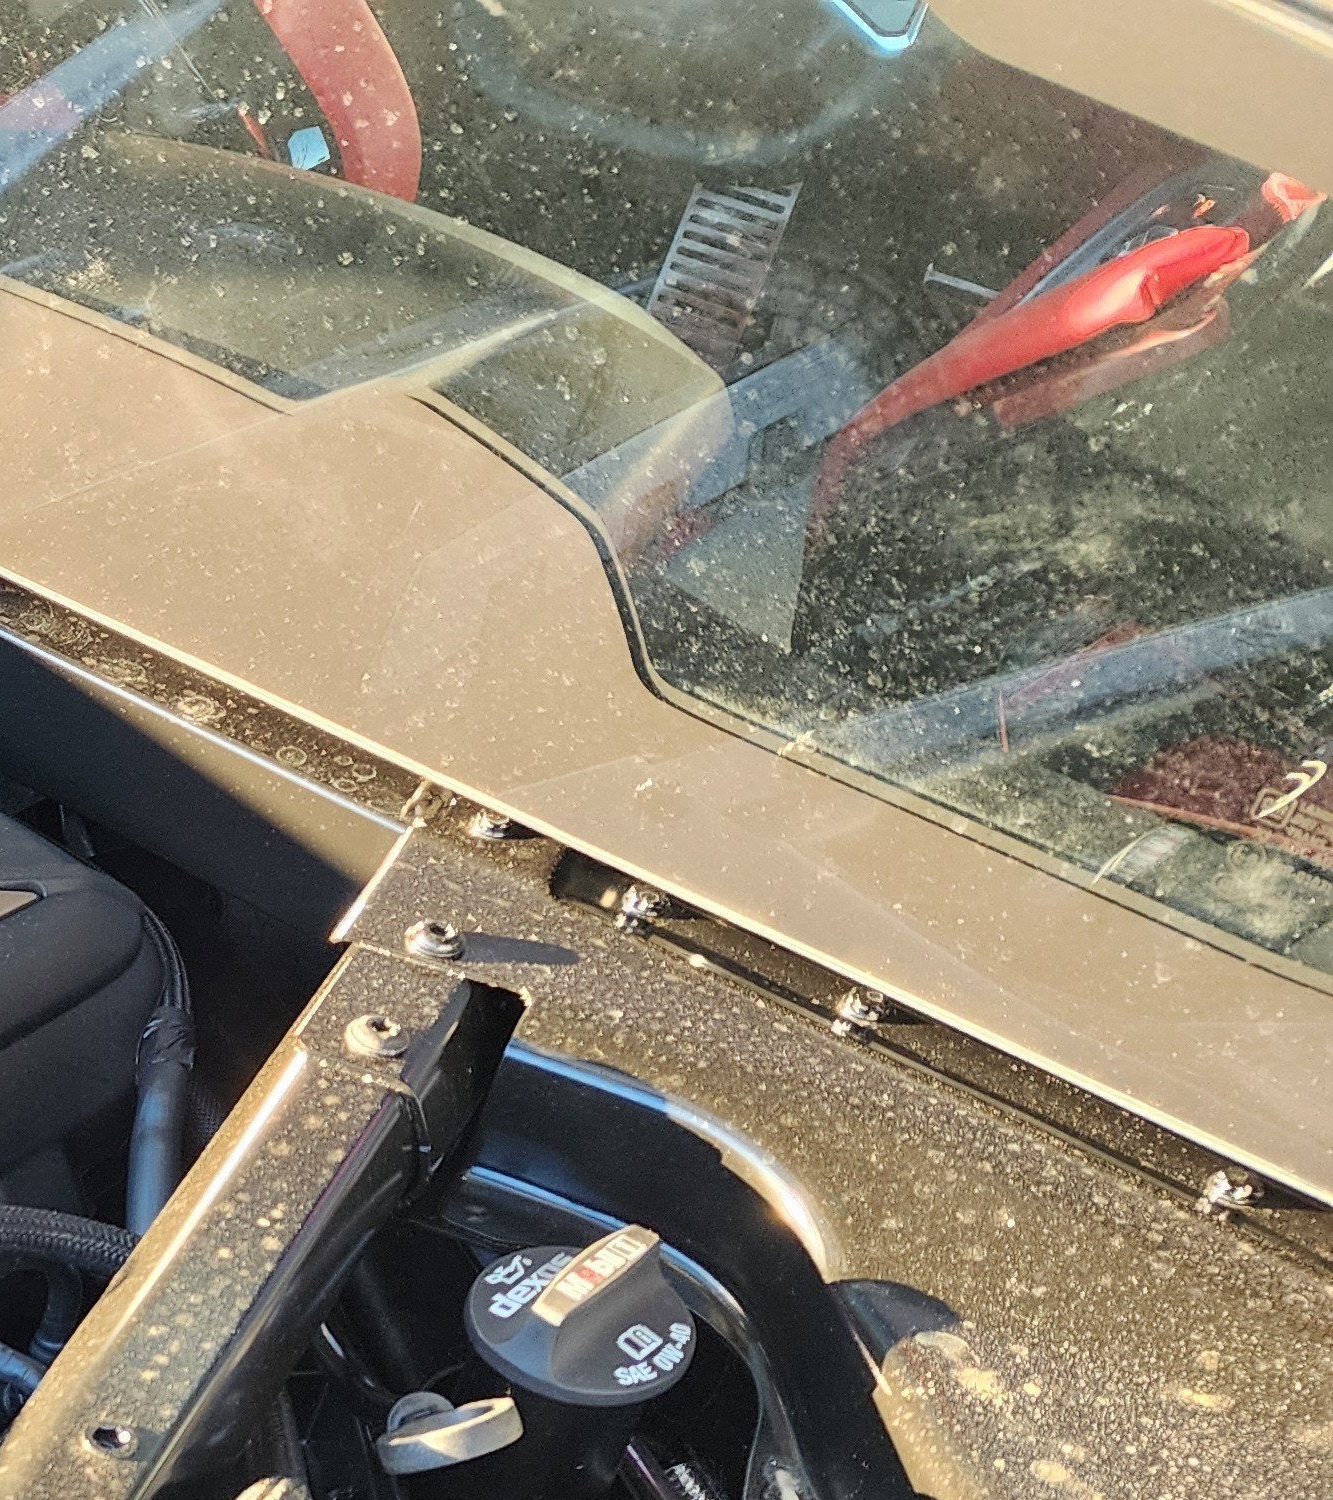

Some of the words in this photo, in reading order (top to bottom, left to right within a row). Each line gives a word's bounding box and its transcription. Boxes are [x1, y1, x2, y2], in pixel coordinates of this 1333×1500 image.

[488, 1252, 575, 1319] dexos
[613, 1361, 658, 1387] SAE
[652, 1322, 692, 1372] 0W-40
